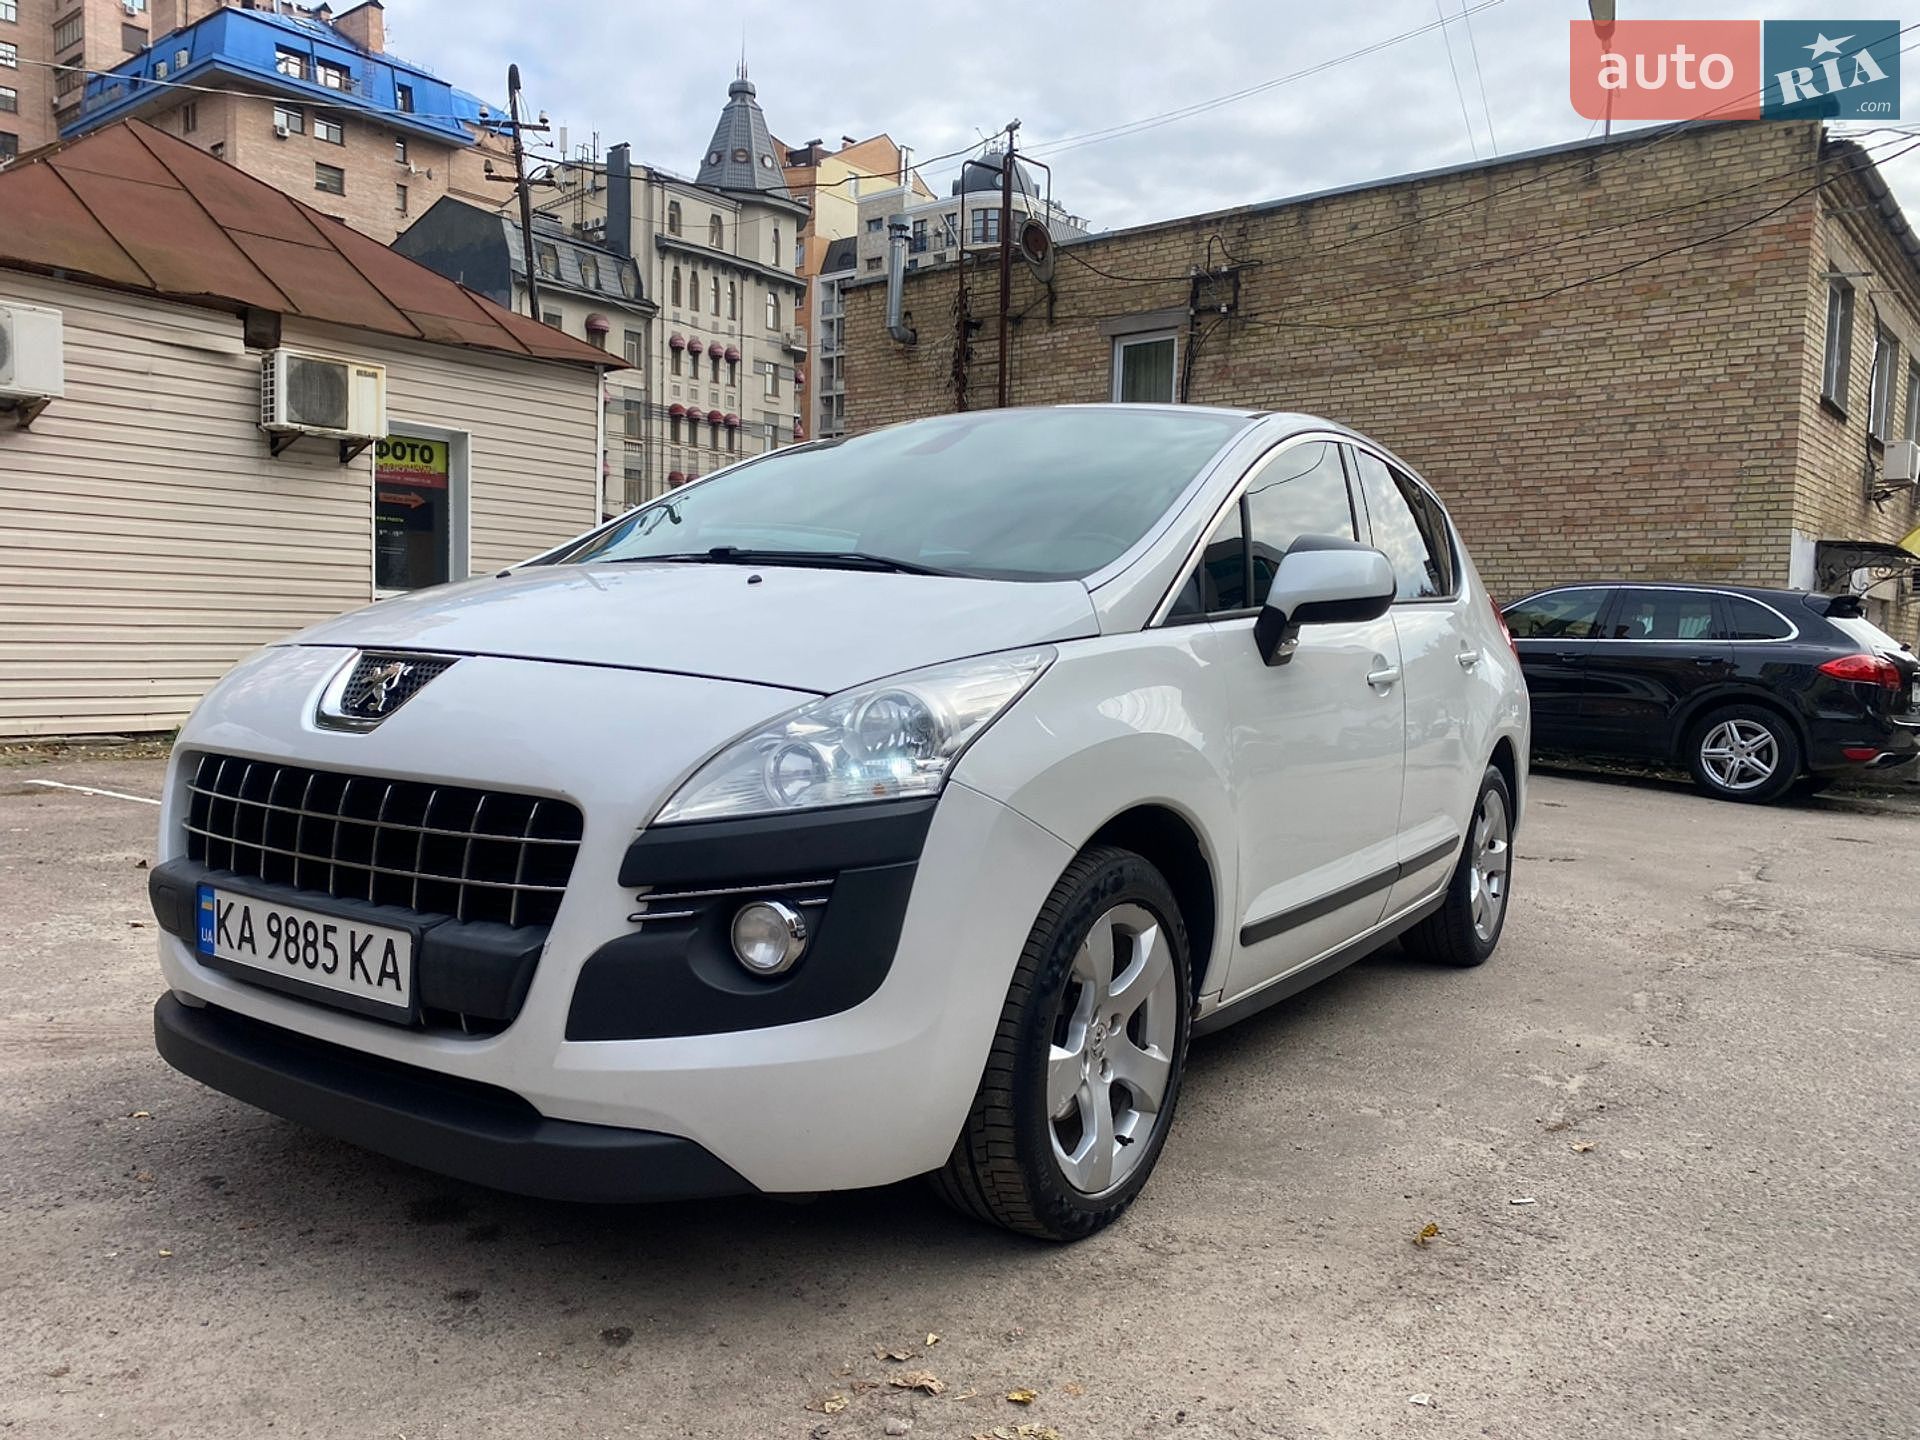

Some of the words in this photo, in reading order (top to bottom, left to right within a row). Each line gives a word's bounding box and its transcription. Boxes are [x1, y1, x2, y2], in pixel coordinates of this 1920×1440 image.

[375, 440, 434, 463] ФОТО
[201, 927, 214, 944] UA
[216, 899, 257, 955] KA
[267, 912, 339, 974] 9885
[350, 930, 402, 992] KA
